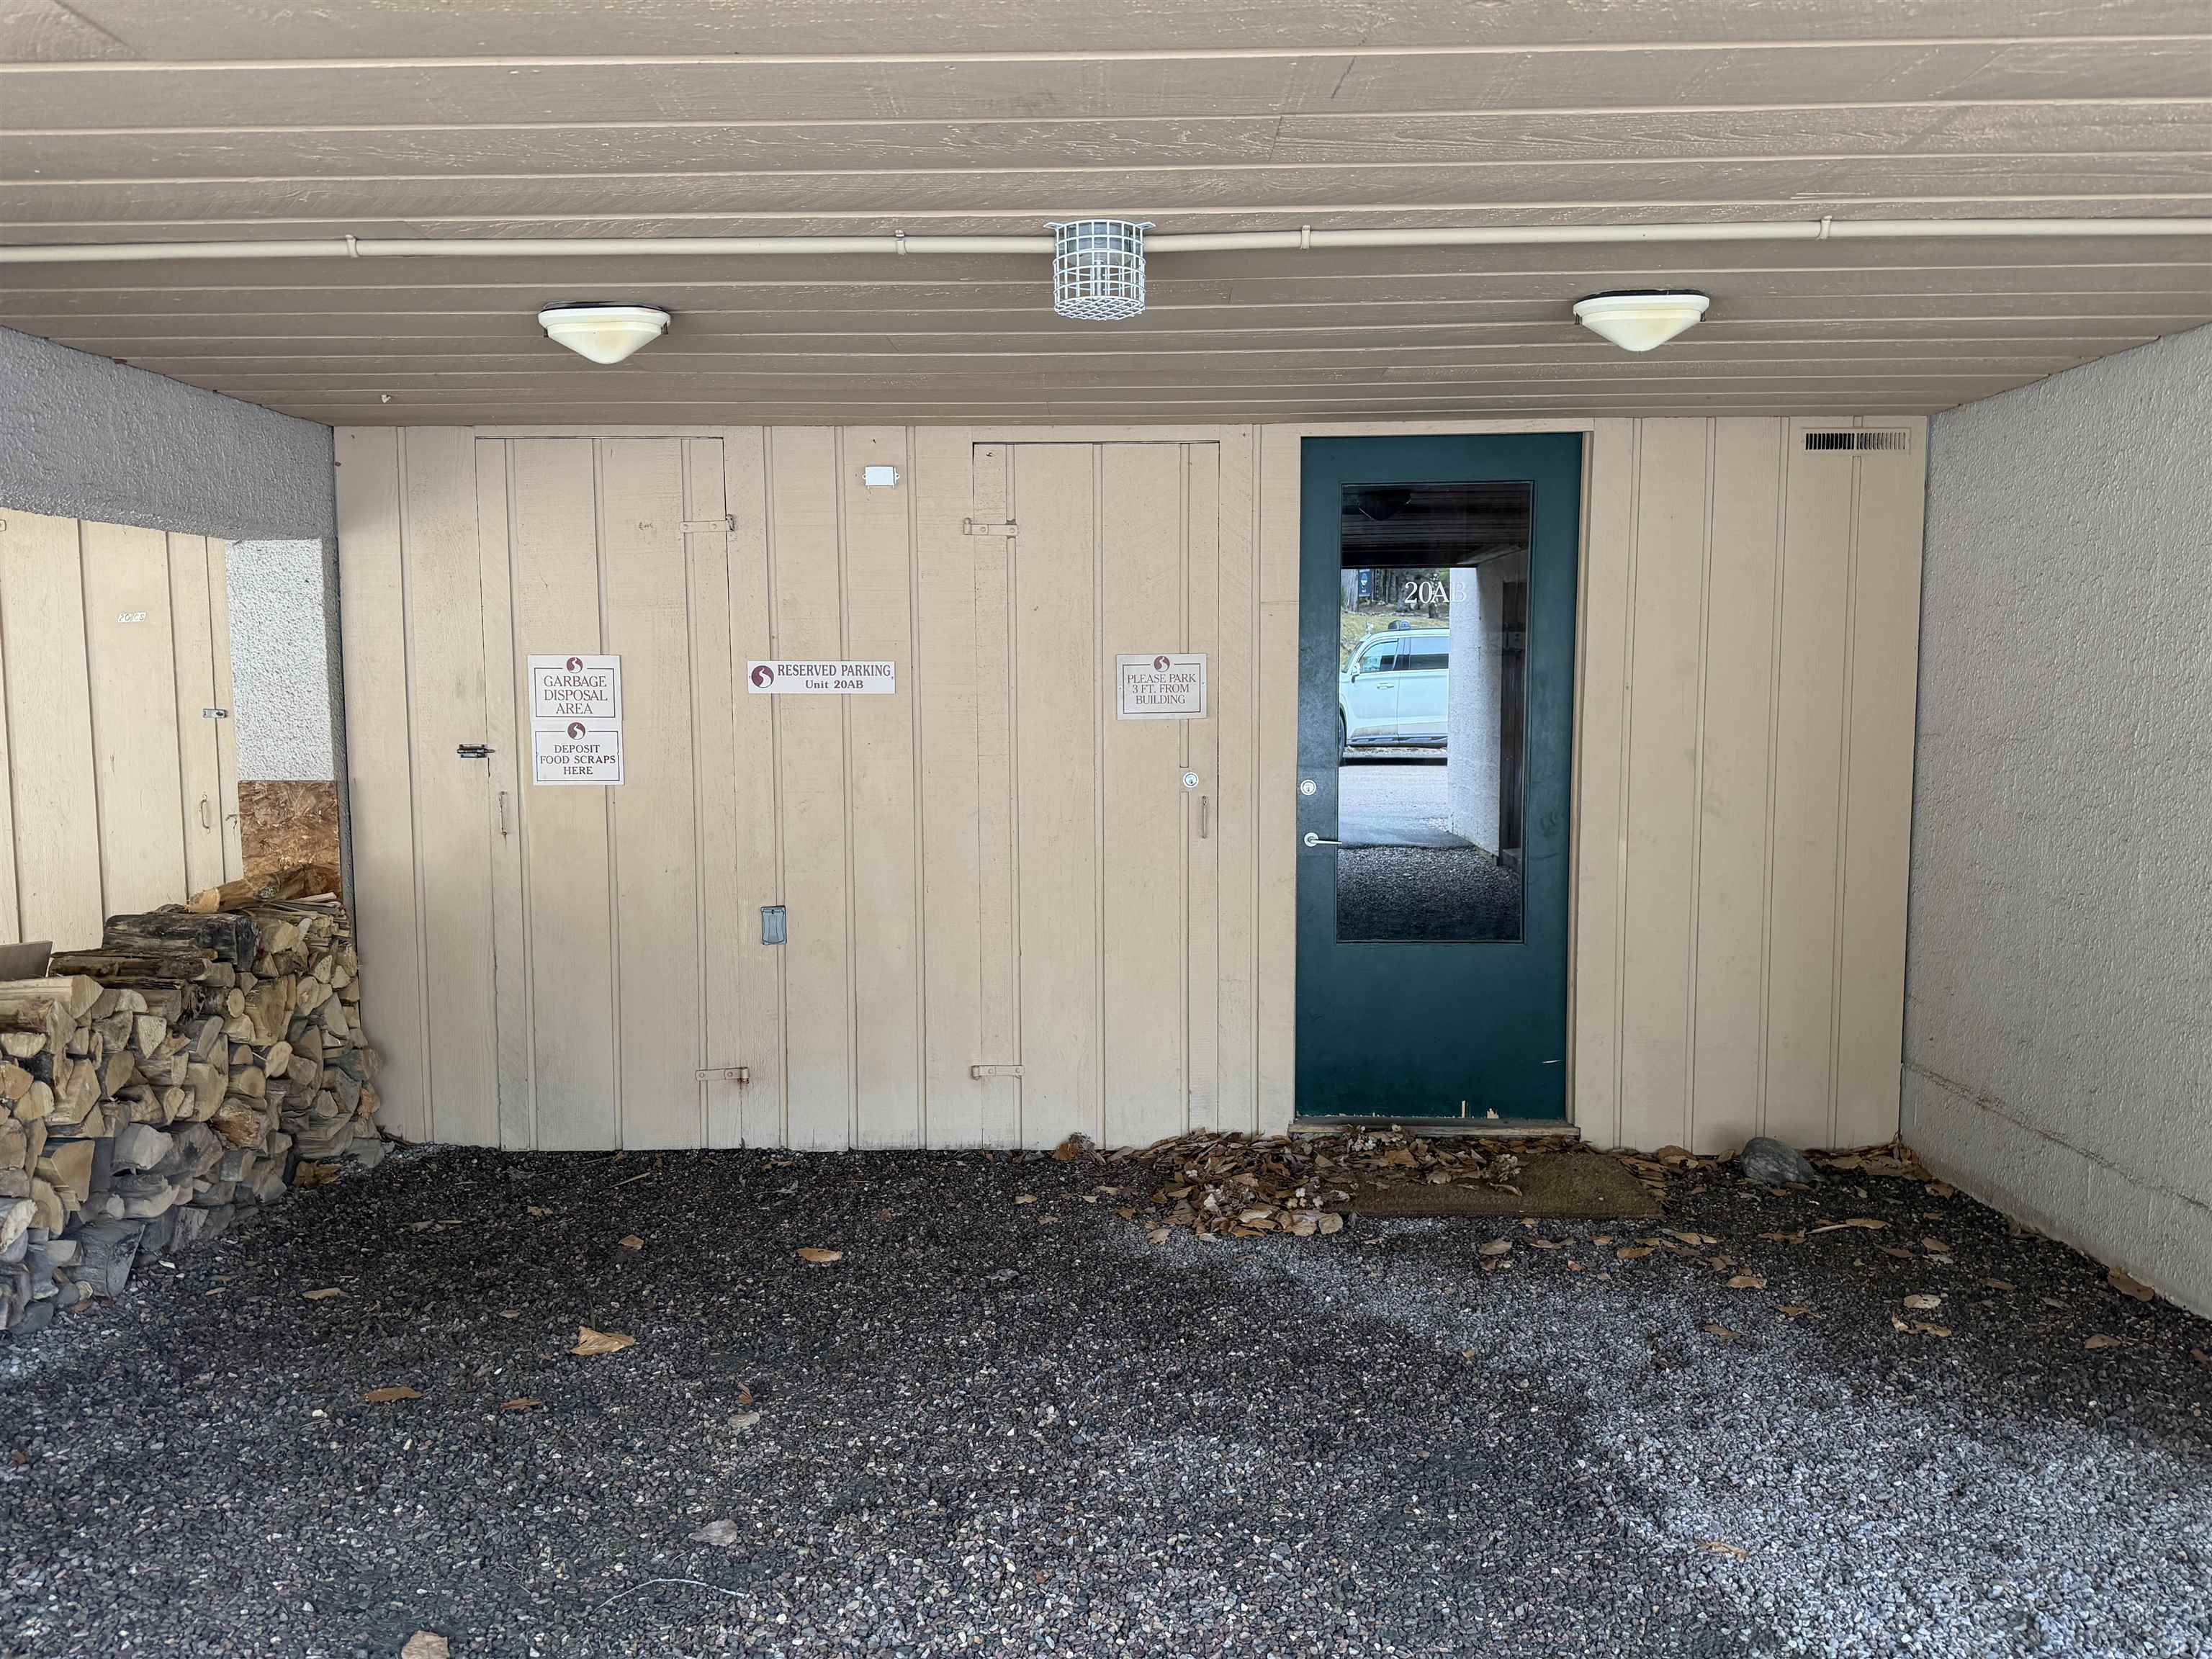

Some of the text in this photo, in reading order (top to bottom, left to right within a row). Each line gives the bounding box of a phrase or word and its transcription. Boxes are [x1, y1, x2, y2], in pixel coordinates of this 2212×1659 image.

[1404, 581, 1467, 603] 20AB
[777, 664, 891, 677] RESERVED PARKING
[543, 675, 607, 688] GARBAGE
[1128, 673, 1196, 684] PLEASE PARK
[805, 680, 863, 689] Unit 20AB
[1132, 683, 1189, 693] 3 FT. FROM
[544, 689, 608, 701] DISPOSAL
[1136, 695, 1186, 705] BUILDING
[555, 703, 594, 714] AREA
[554, 744, 601, 753] DEPOSIT
[540, 755, 616, 764] FOOD SCRAPS
[563, 766, 593, 775] HERE
